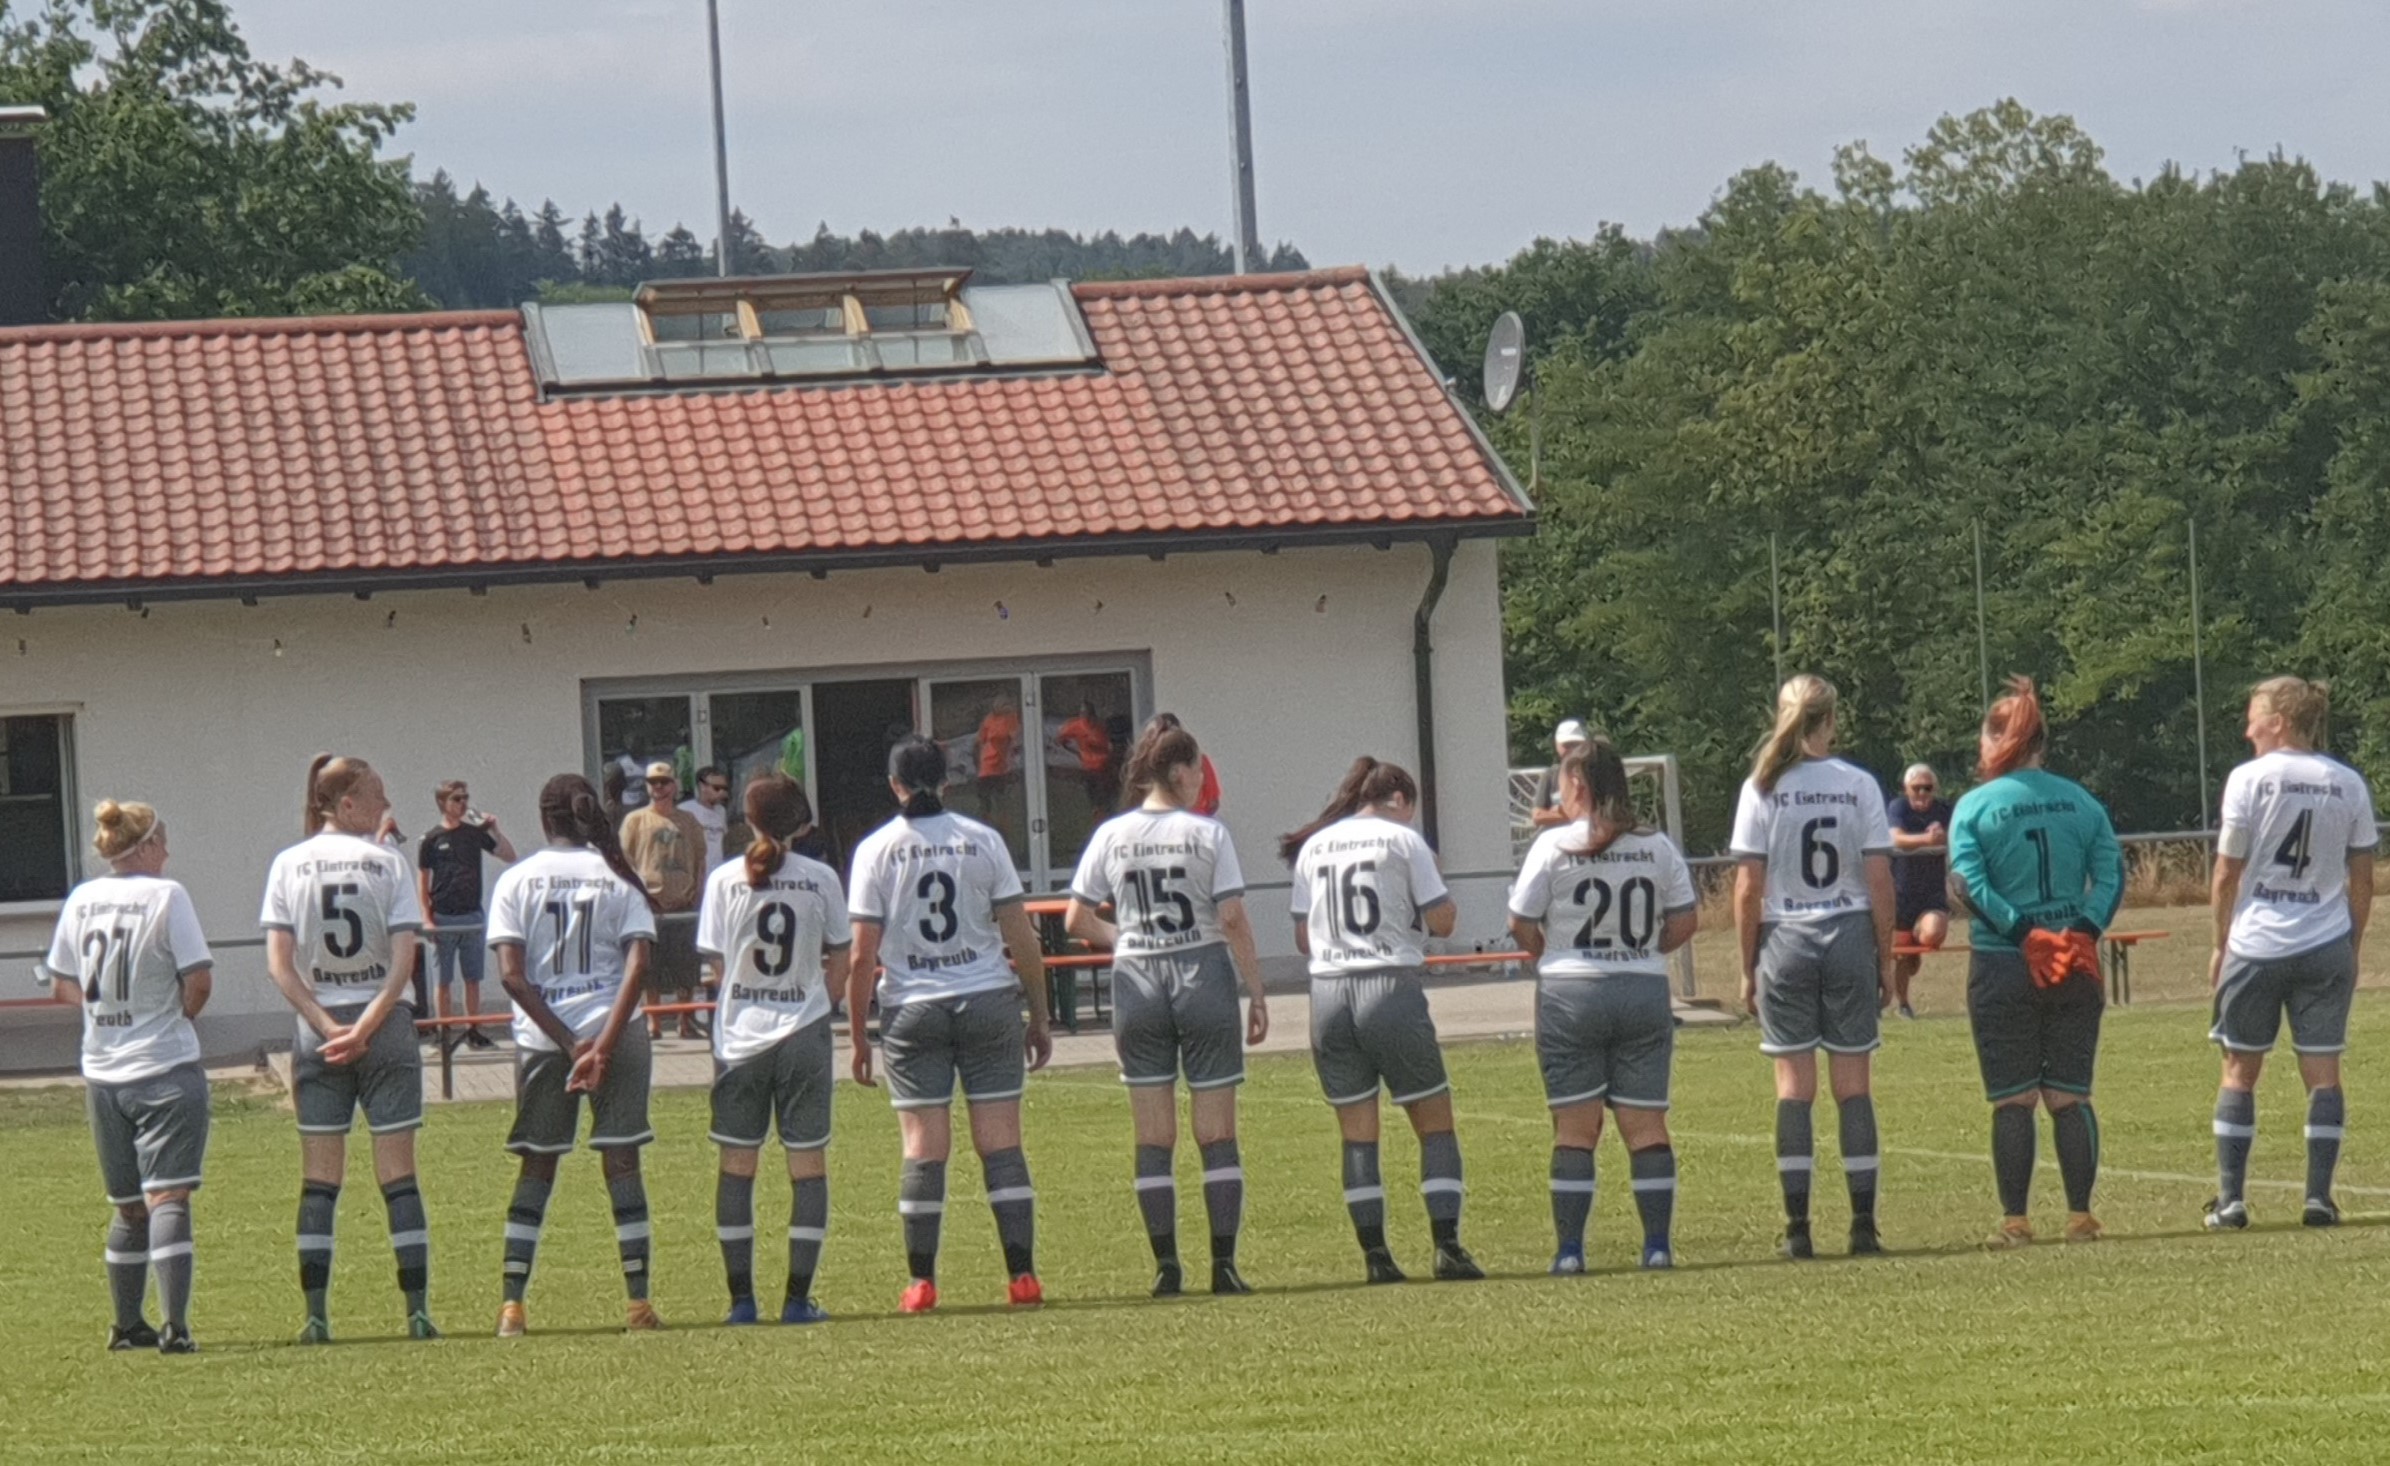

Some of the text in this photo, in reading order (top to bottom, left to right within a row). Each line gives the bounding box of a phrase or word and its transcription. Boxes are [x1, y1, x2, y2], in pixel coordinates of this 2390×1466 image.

[1773, 790, 1857, 809] FC Eintracht
[2257, 781, 2342, 798] FC Eintracht
[1992, 801, 2076, 826] FC Eintracht
[890, 843, 977, 866] FC Eintracht
[1113, 841, 1200, 861] FC Eintracht
[1309, 836, 1393, 860] FC Eintracht
[1801, 816, 1839, 889] 6
[2273, 808, 2313, 879] 4
[297, 860, 383, 879] FC Eintracht
[2024, 827, 2051, 903] 1
[528, 875, 616, 892] FC Eintracht
[731, 882, 749, 898] FC
[2252, 881, 2320, 904] Bayreuth
[917, 870, 958, 943] 3
[1124, 866, 1195, 935] 15
[1317, 860, 1381, 940] 16
[1573, 876, 1655, 949] 20
[1783, 890, 1853, 912] Bayreuth
[321, 883, 363, 959] 5
[545, 900, 595, 975] 11
[756, 901, 796, 977] 9
[82, 927, 134, 1003] 21
[907, 947, 978, 972] Bayreuth
[312, 963, 386, 986] Bayreuth
[731, 983, 806, 1003] Bayreuth
